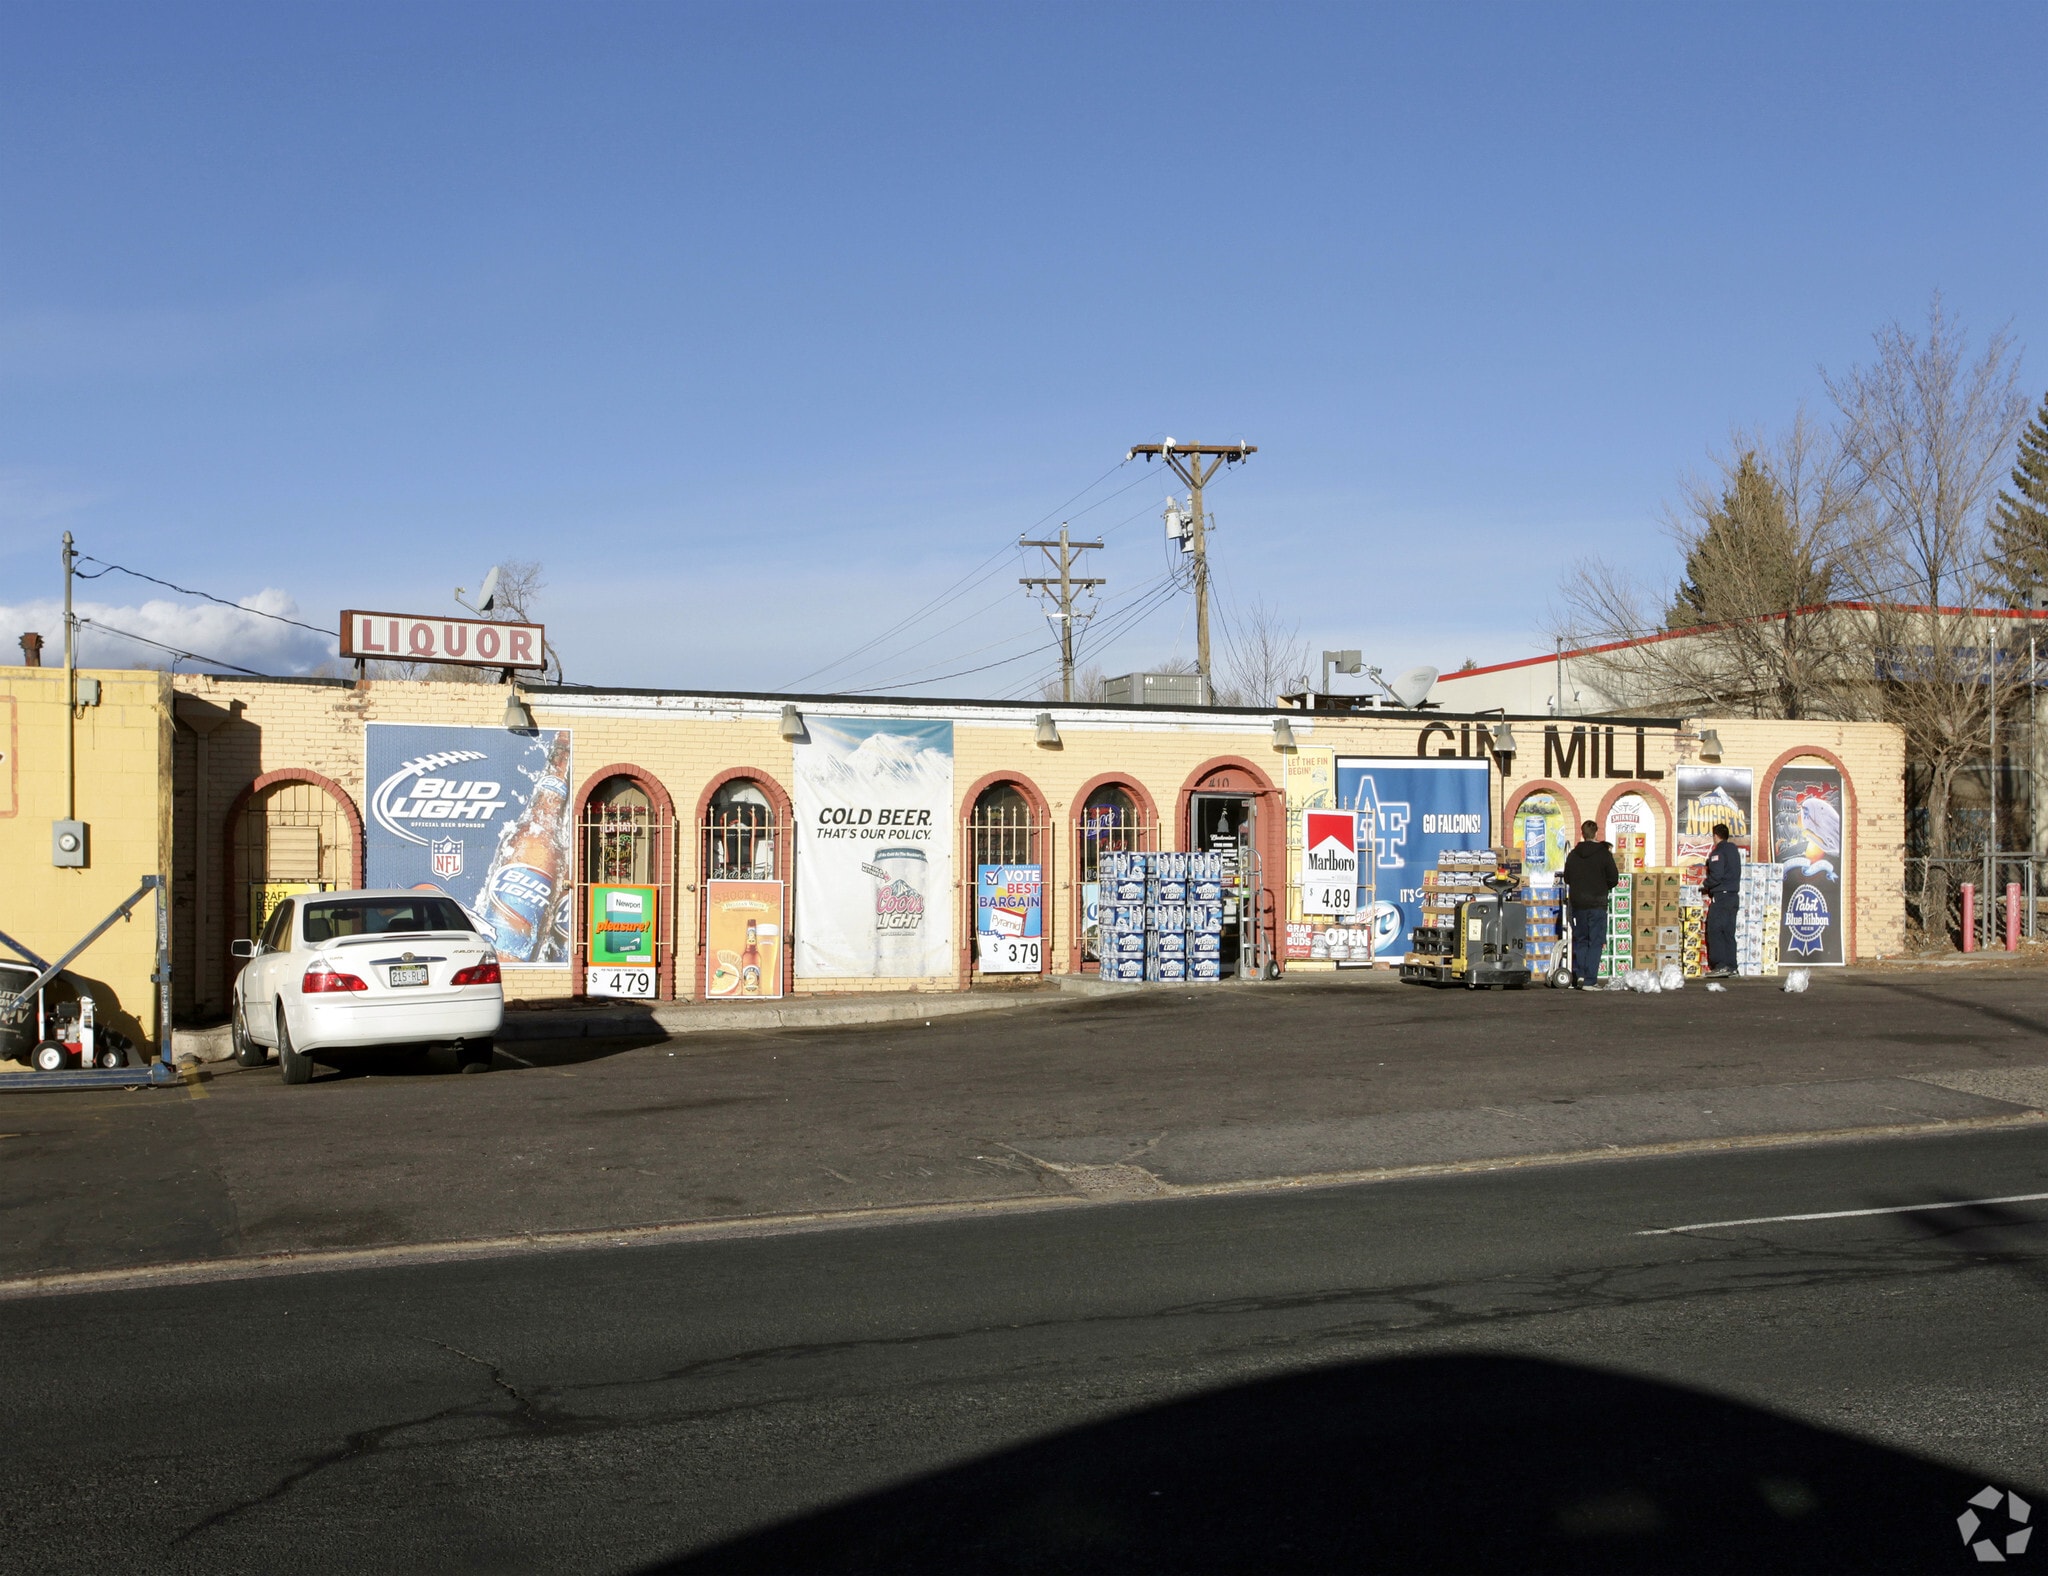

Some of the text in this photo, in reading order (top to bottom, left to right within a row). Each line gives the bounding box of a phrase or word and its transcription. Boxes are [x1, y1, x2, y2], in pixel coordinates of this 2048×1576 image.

[362, 618, 534, 661] LIQUOR
[1418, 721, 1664, 779] GIN MILL
[1287, 756, 1328, 767] LET THE FIN
[409, 778, 501, 800] BUD
[388, 797, 507, 820] LIGHT
[818, 807, 933, 826] COLD BEER.
[1686, 799, 1746, 835] NUGGETS
[1423, 814, 1481, 834] GO FALCONS!
[1612, 814, 1639, 823] SMIRNOFF
[816, 828, 931, 840] THAT'S OUR POLICY.
[435, 855, 460, 873] NFL
[1308, 849, 1355, 871] Marlboro
[502, 869, 551, 898] BUD
[1004, 870, 1040, 882] VOTE
[256, 891, 288, 901] DRAFT
[492, 879, 550, 909] LIGHT
[1007, 883, 1040, 894] BEST
[1400, 888, 1415, 903] IT'S
[615, 898, 641, 909] Newport
[877, 885, 924, 914] Coors
[979, 896, 1040, 908] BARGAIN
[1322, 888, 1350, 908] 4.89
[1795, 894, 1819, 911] Pabst
[256, 911, 267, 920] IN
[877, 913, 922, 929] LIGHT
[992, 914, 1021, 931] Pyramid
[1785, 912, 1829, 926] Blue Ribbon
[595, 919, 651, 935] pleasure!
[1286, 924, 1312, 933] GRAB
[1286, 937, 1312, 946] BUDS
[1325, 928, 1368, 947] OPEN
[1511, 939, 1523, 950] P6
[993, 943, 1038, 964] $ 3.79
[592, 972, 650, 995] $ 4.79
